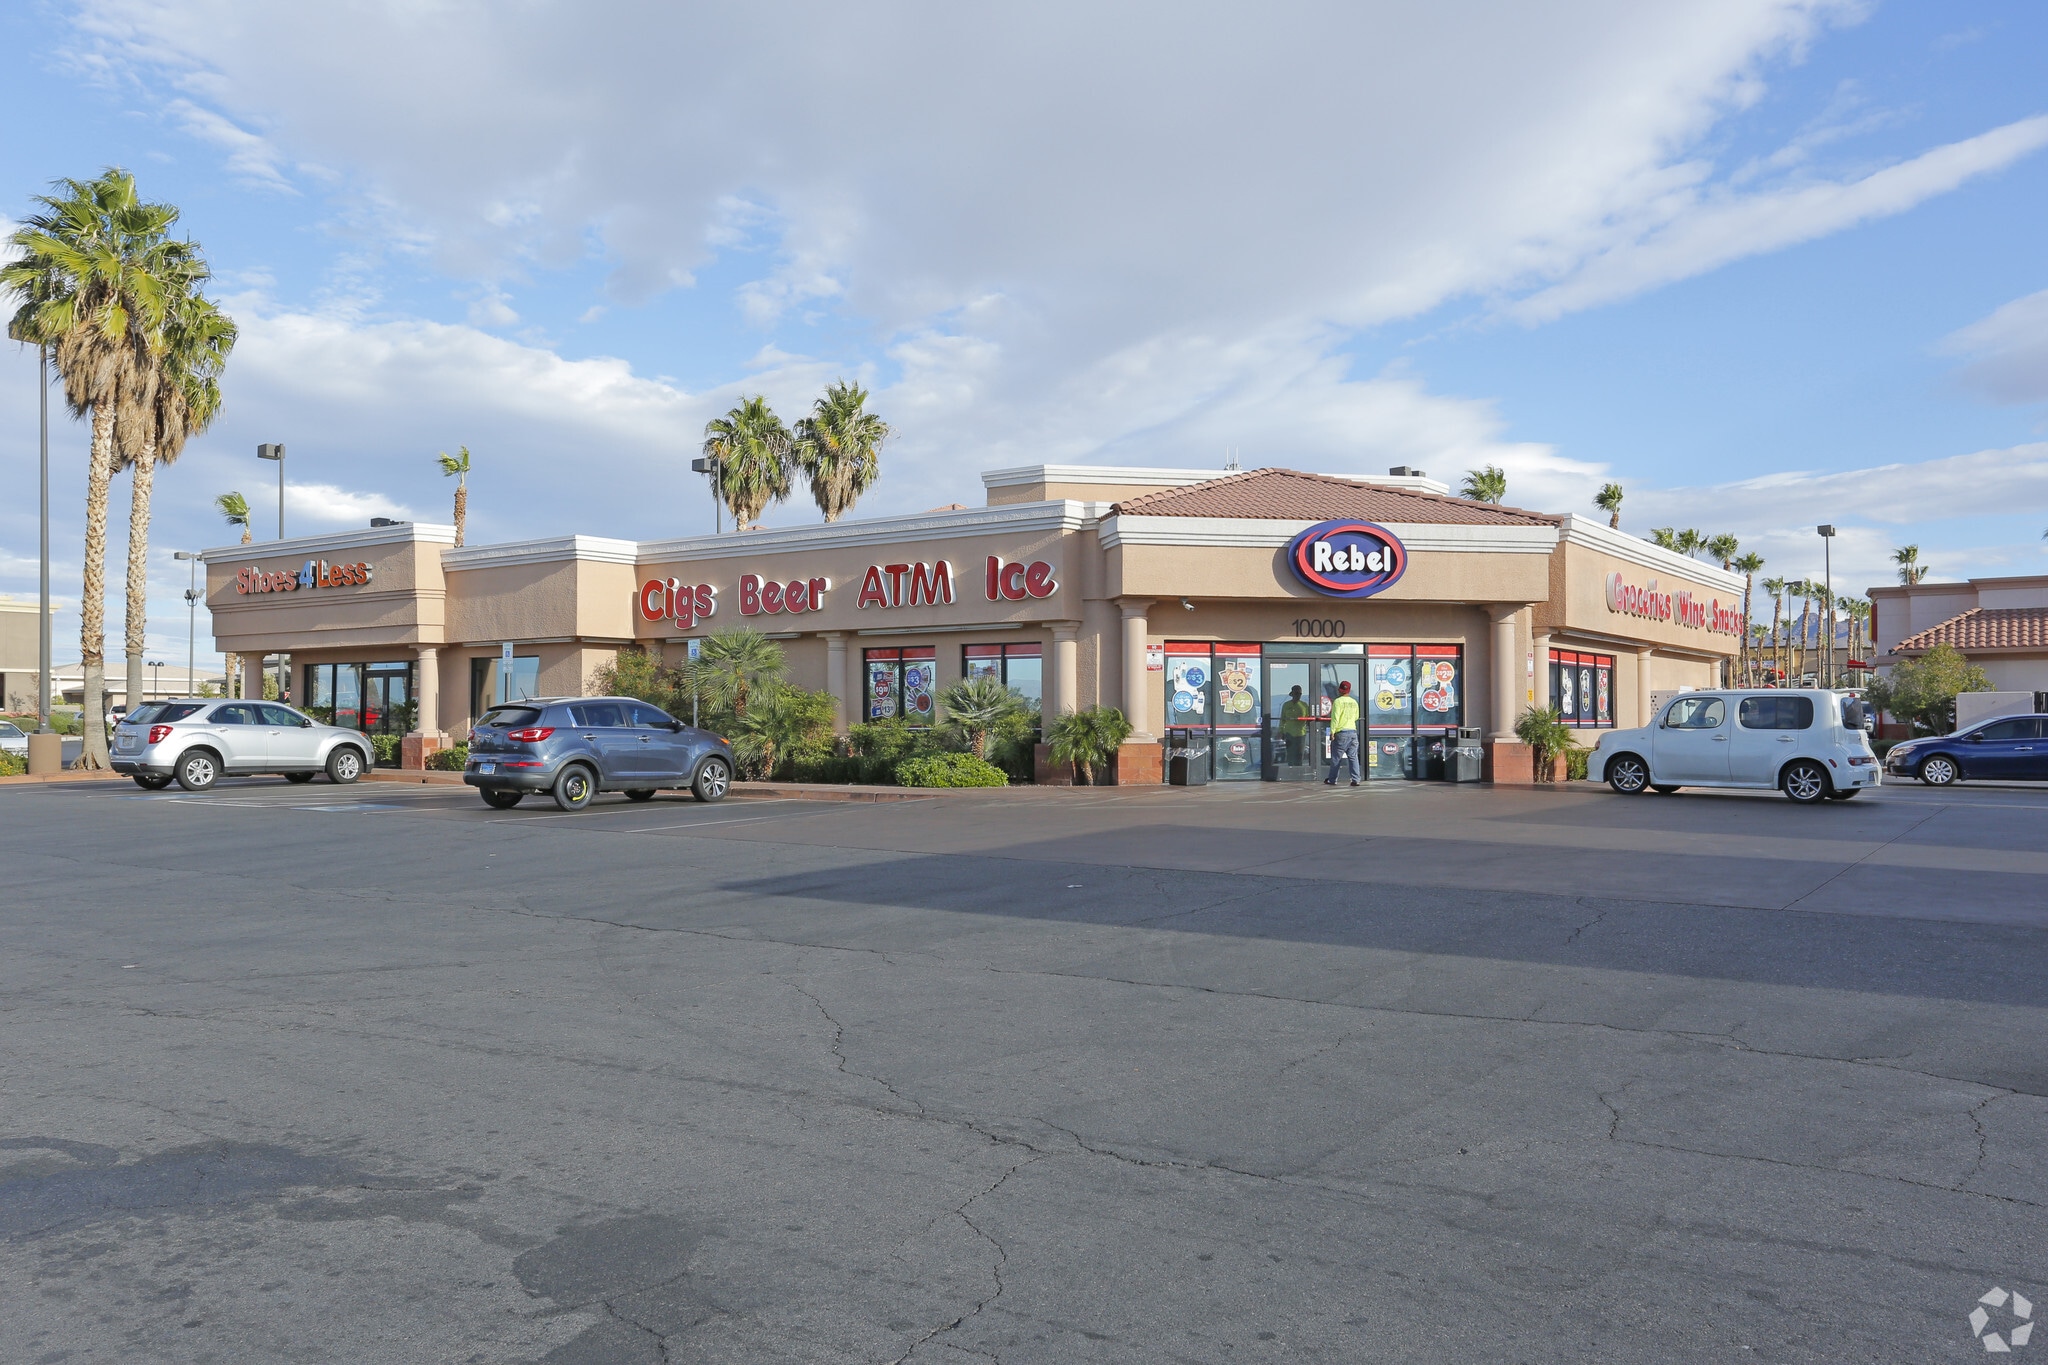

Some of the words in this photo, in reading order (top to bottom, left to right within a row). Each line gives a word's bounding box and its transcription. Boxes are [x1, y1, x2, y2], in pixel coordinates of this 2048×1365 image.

[1314, 541, 1391, 572] Rebel
[236, 566, 298, 594] Shoes
[299, 560, 315, 588] 4
[317, 559, 372, 587] Less
[640, 577, 718, 630] Cigs
[739, 574, 831, 615] Beer
[857, 560, 957, 609] ATM
[985, 555, 1059, 601] Ice
[1607, 572, 1671, 621] Groceries
[1673, 590, 1705, 628] Wine
[1706, 598, 1744, 636] Snacks
[1292, 619, 1345, 638] 10000
